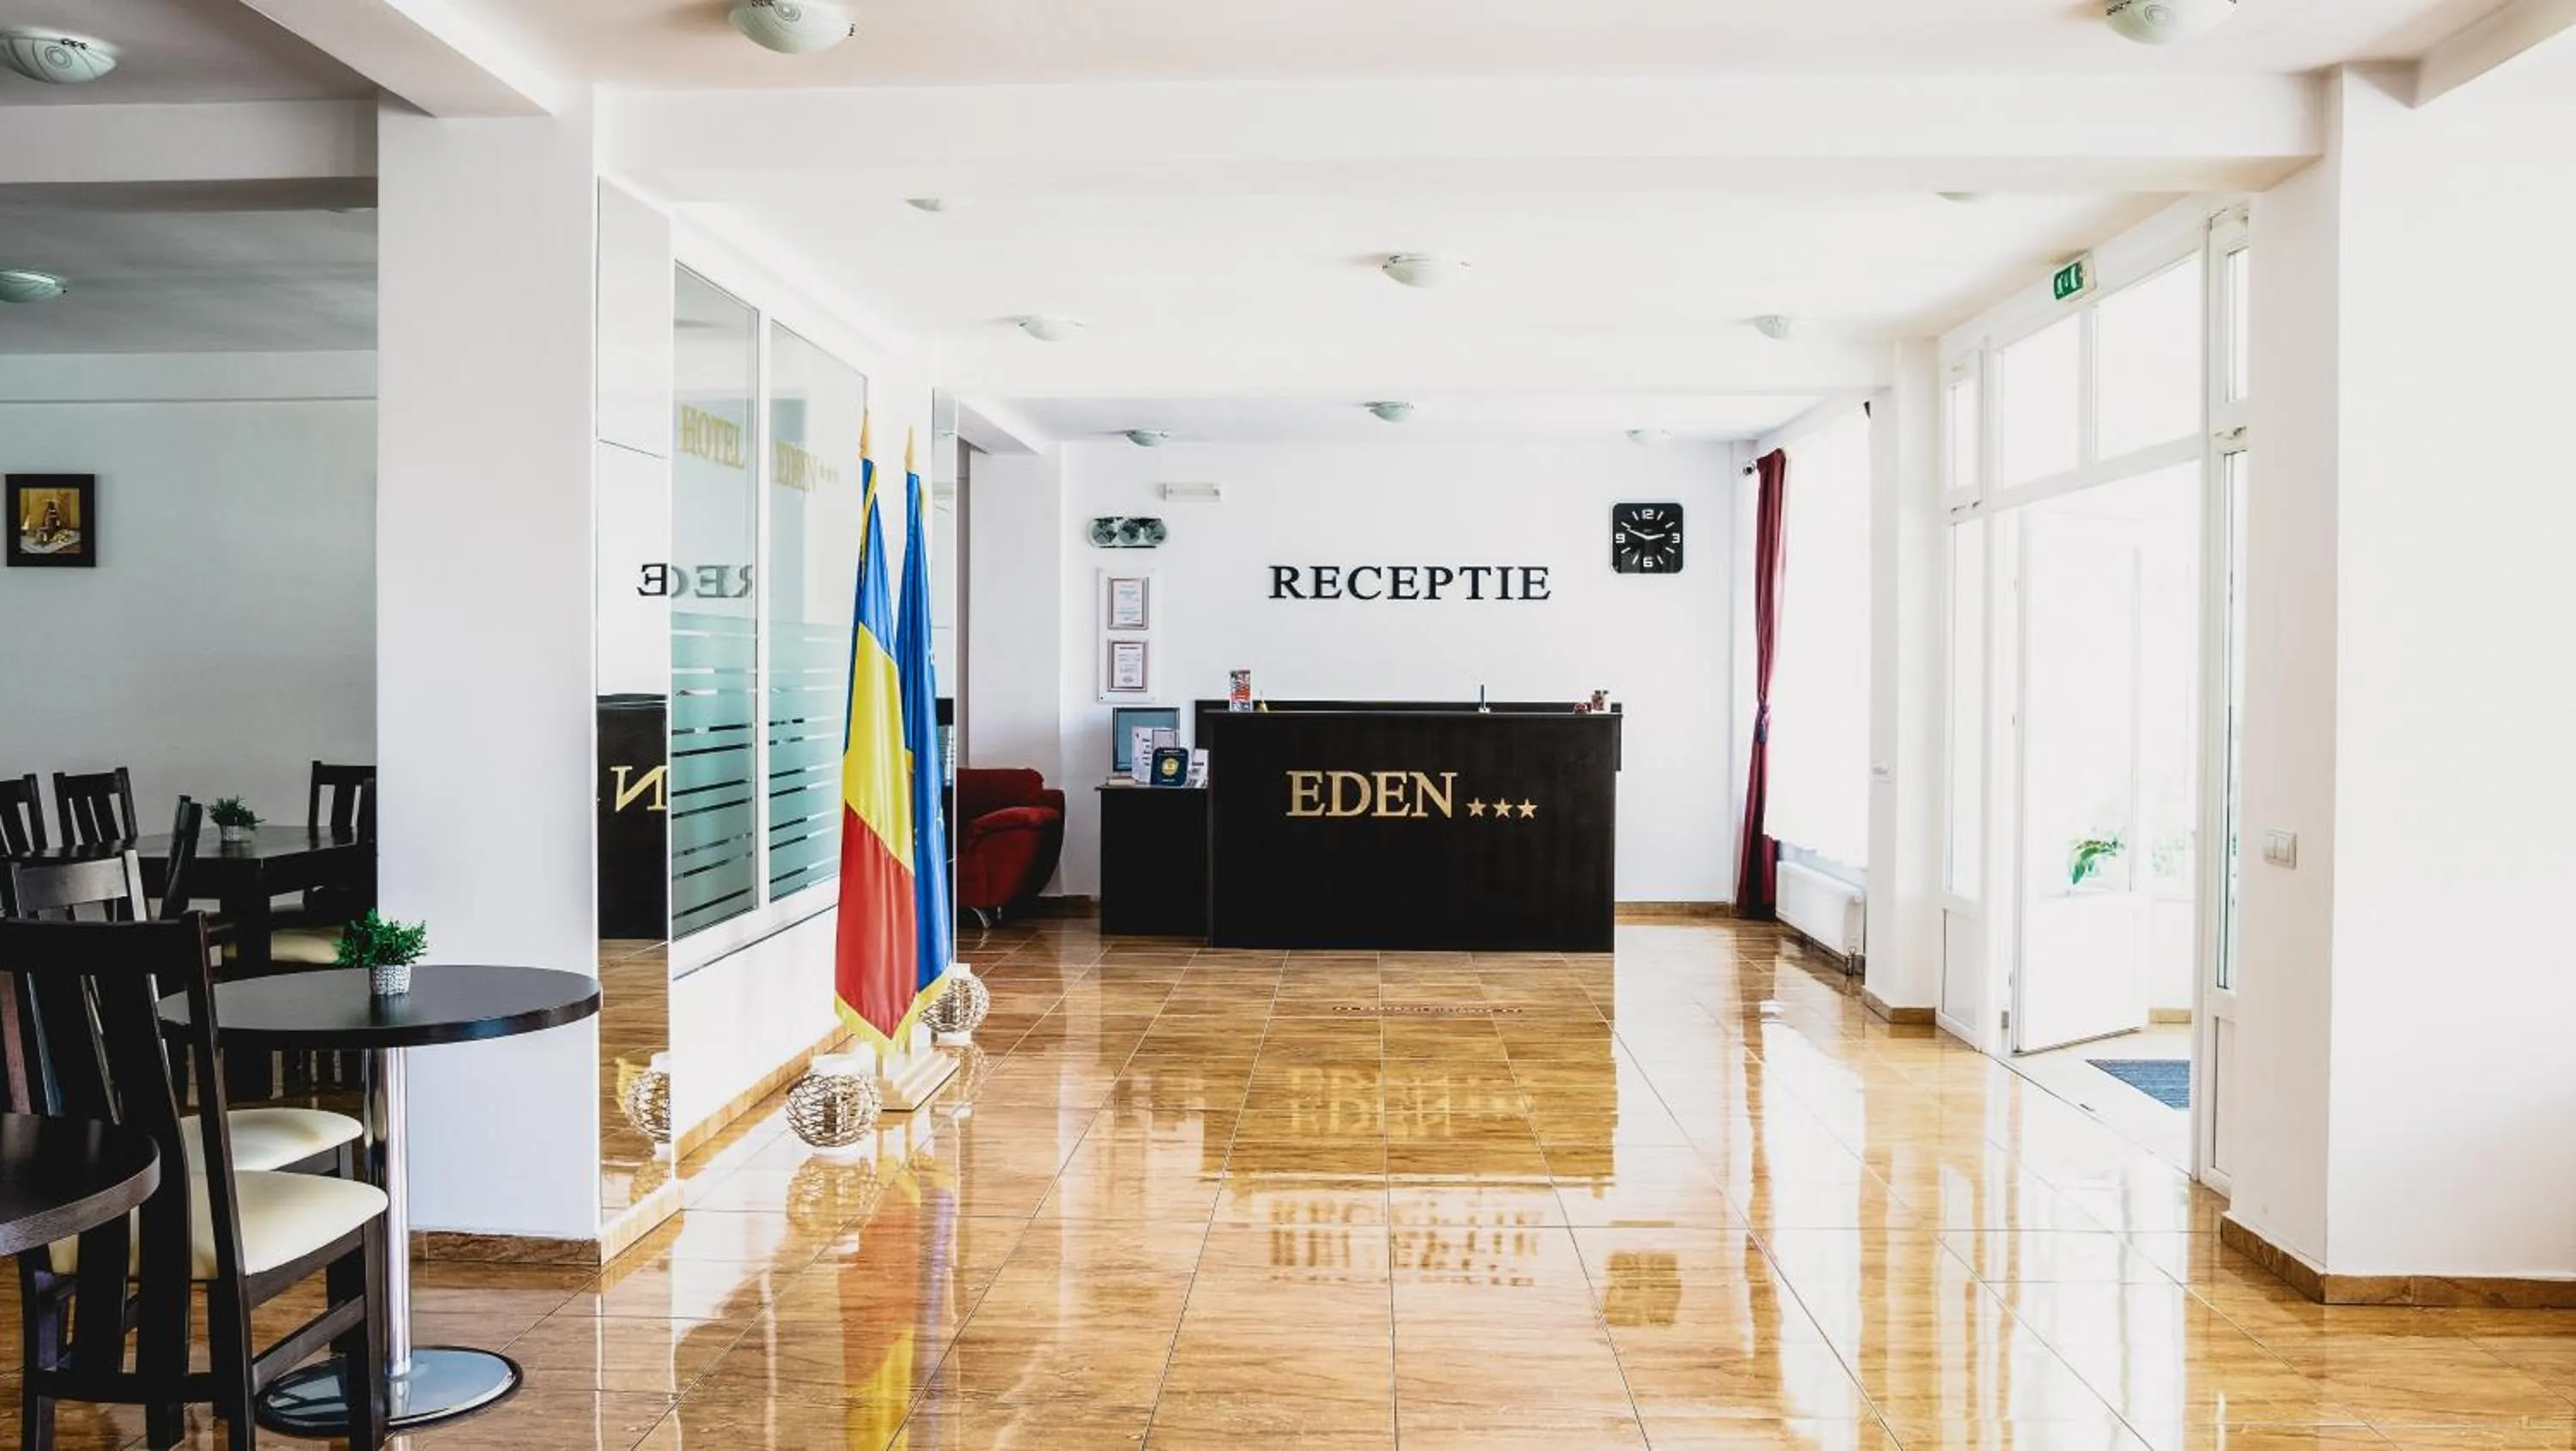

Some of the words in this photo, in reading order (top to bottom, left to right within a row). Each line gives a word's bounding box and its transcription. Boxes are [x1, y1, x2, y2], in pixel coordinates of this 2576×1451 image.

[1642, 508, 1654, 519] 12
[1615, 533, 1625, 543] 9
[1671, 533, 1680, 543] 3
[1643, 556, 1653, 568] 6
[1268, 565, 1551, 600] RECEPTIE
[1285, 770, 1458, 818] EDEN
